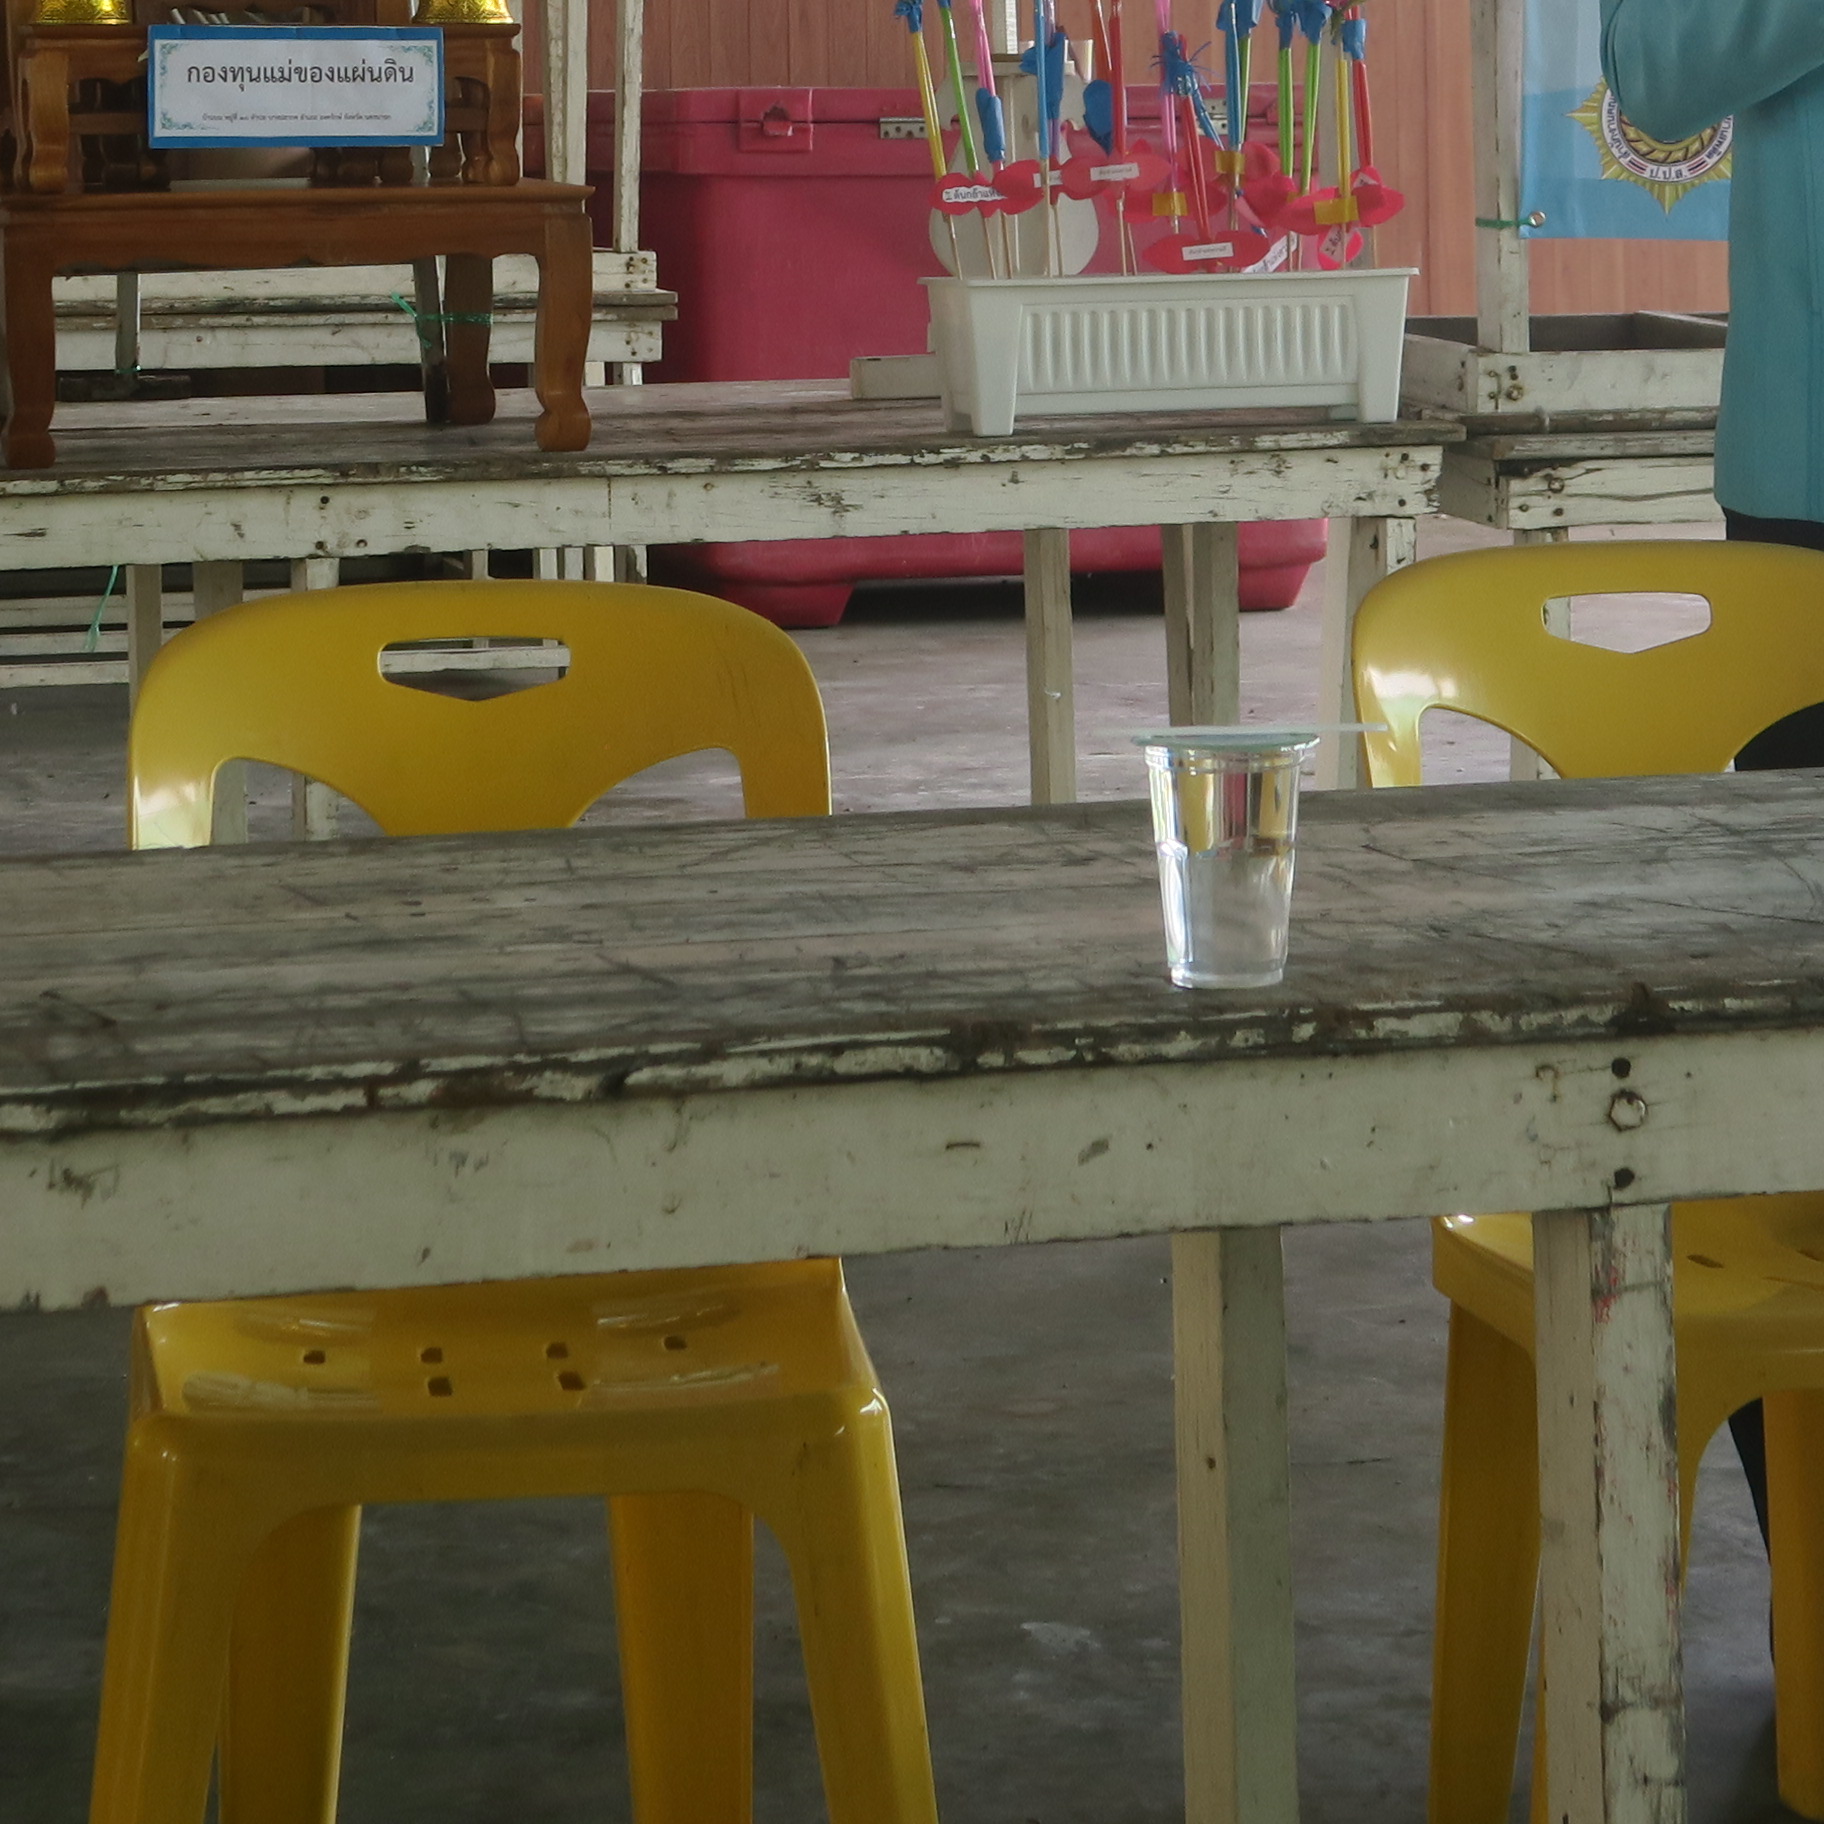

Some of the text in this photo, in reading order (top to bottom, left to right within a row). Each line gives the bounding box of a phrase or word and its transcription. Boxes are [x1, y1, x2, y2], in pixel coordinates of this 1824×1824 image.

[187, 57, 414, 93] กองทุนแม่ของแผ่นดิน
